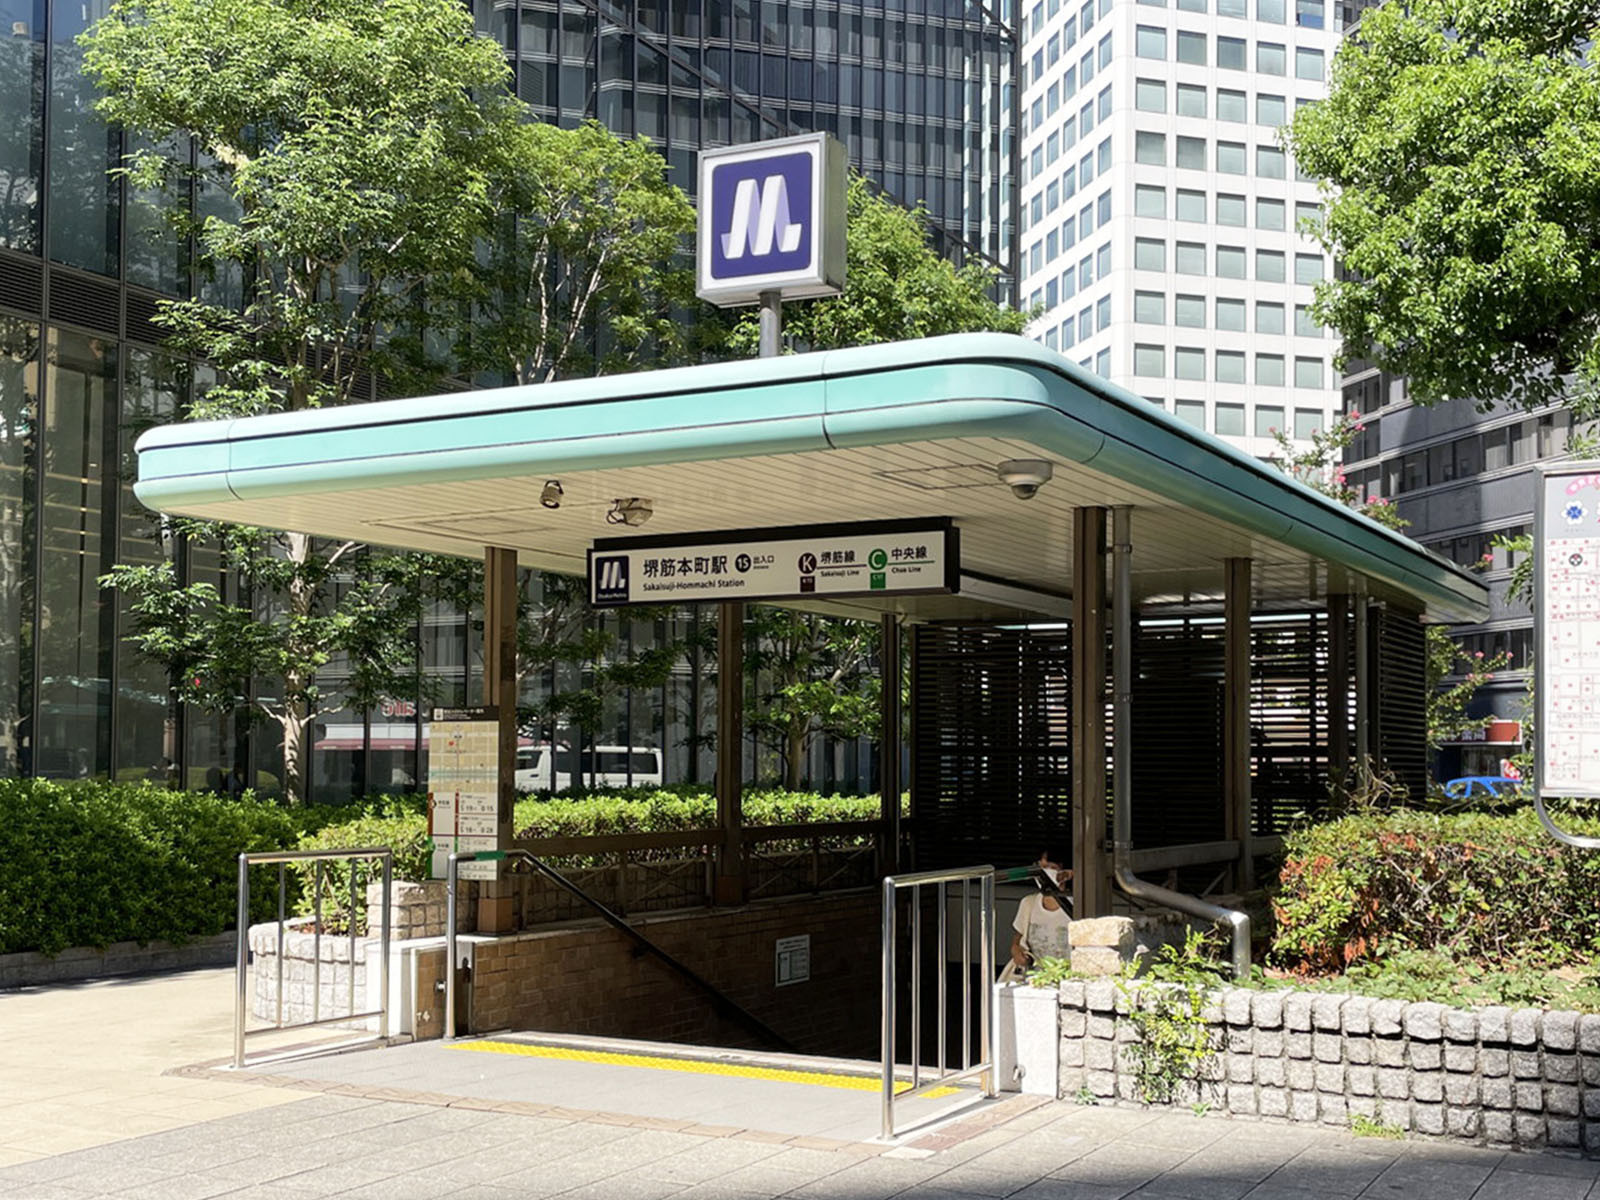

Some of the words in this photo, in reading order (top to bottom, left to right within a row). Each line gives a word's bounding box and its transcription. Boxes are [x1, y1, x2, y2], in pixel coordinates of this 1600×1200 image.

[820, 550, 855, 564] 堺筋線
[891, 545, 928, 560] 中央線
[643, 555, 728, 578] 堺筋本町駅
[753, 555, 774, 565] 出入口
[717, 579, 745, 589] Station
